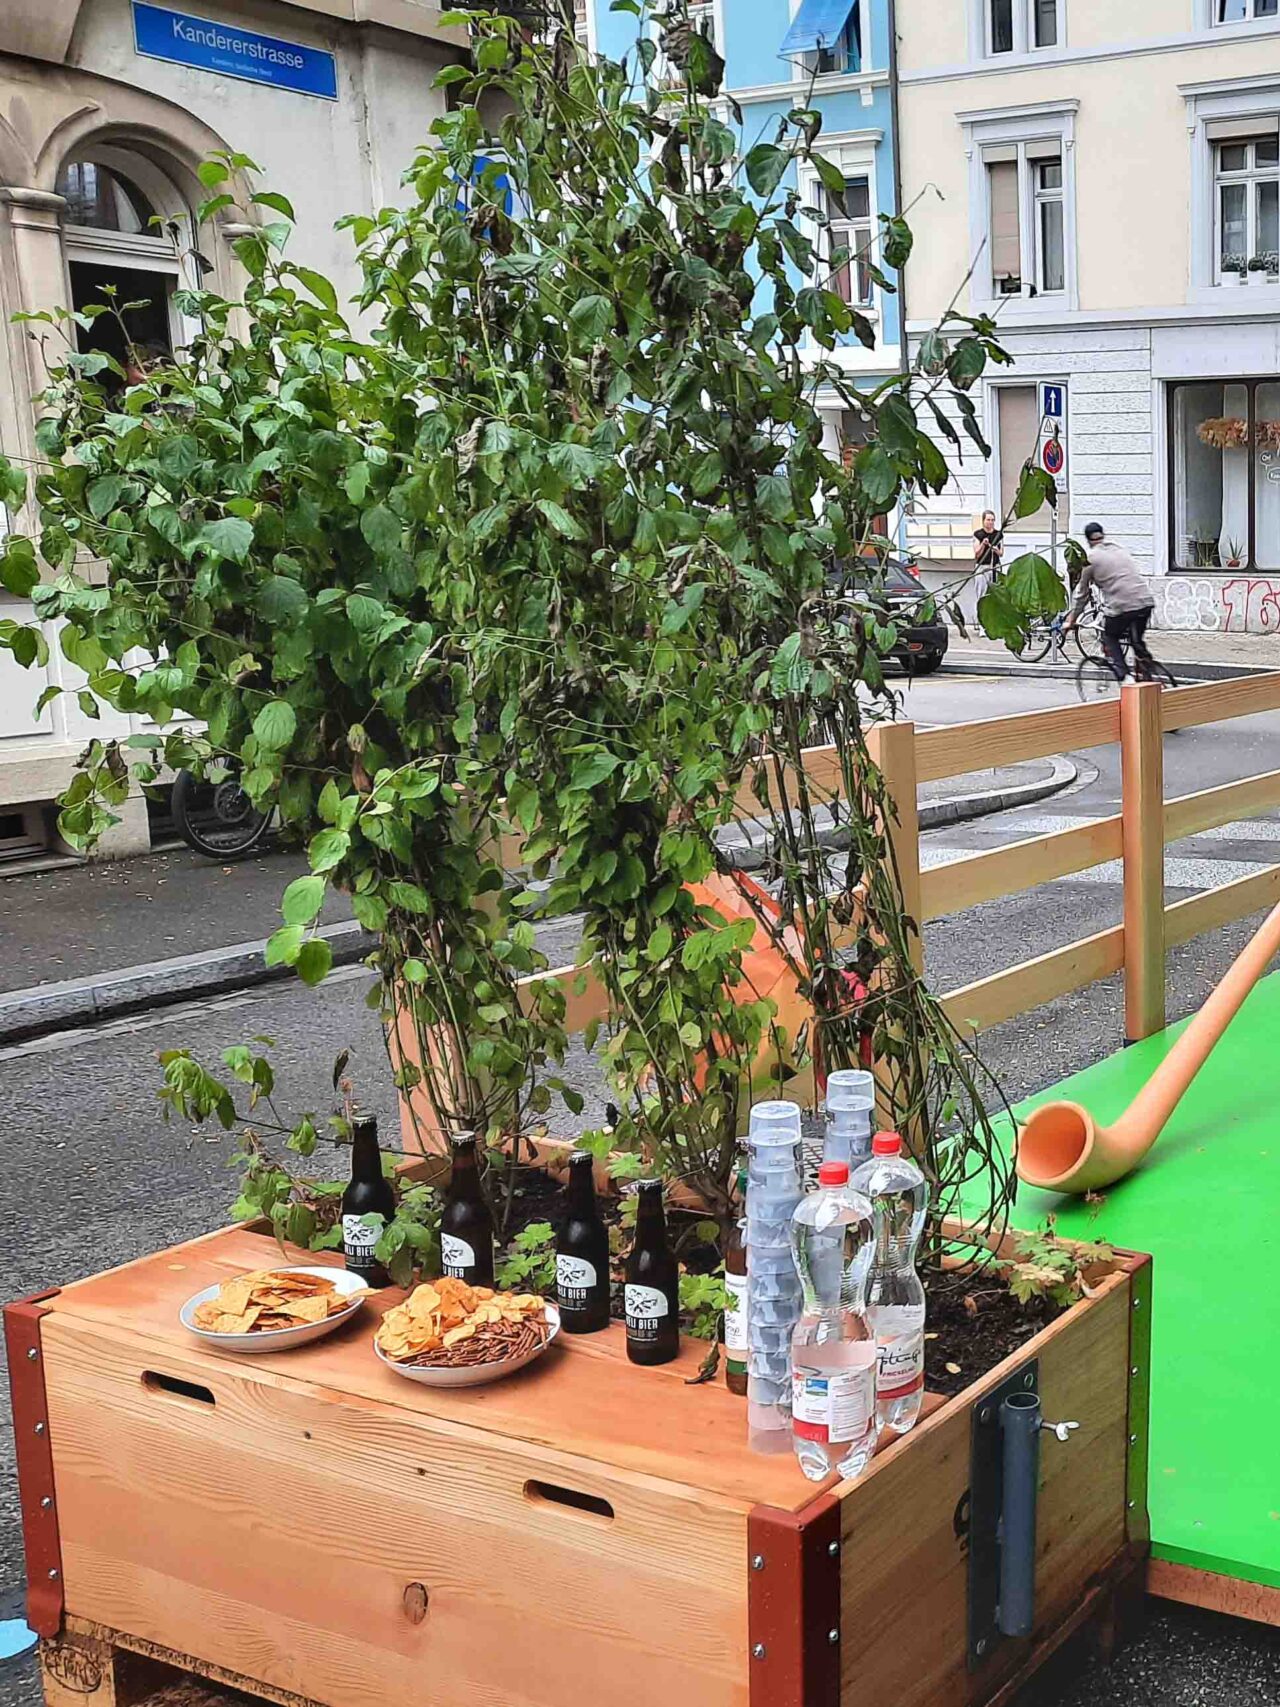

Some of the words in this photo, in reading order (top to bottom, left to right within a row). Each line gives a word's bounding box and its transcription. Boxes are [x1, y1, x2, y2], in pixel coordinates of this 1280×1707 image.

[172, 18, 304, 69] Kandererstrasse
[567, 1288, 587, 1300] BIER
[638, 1318, 658, 1330] BIER
